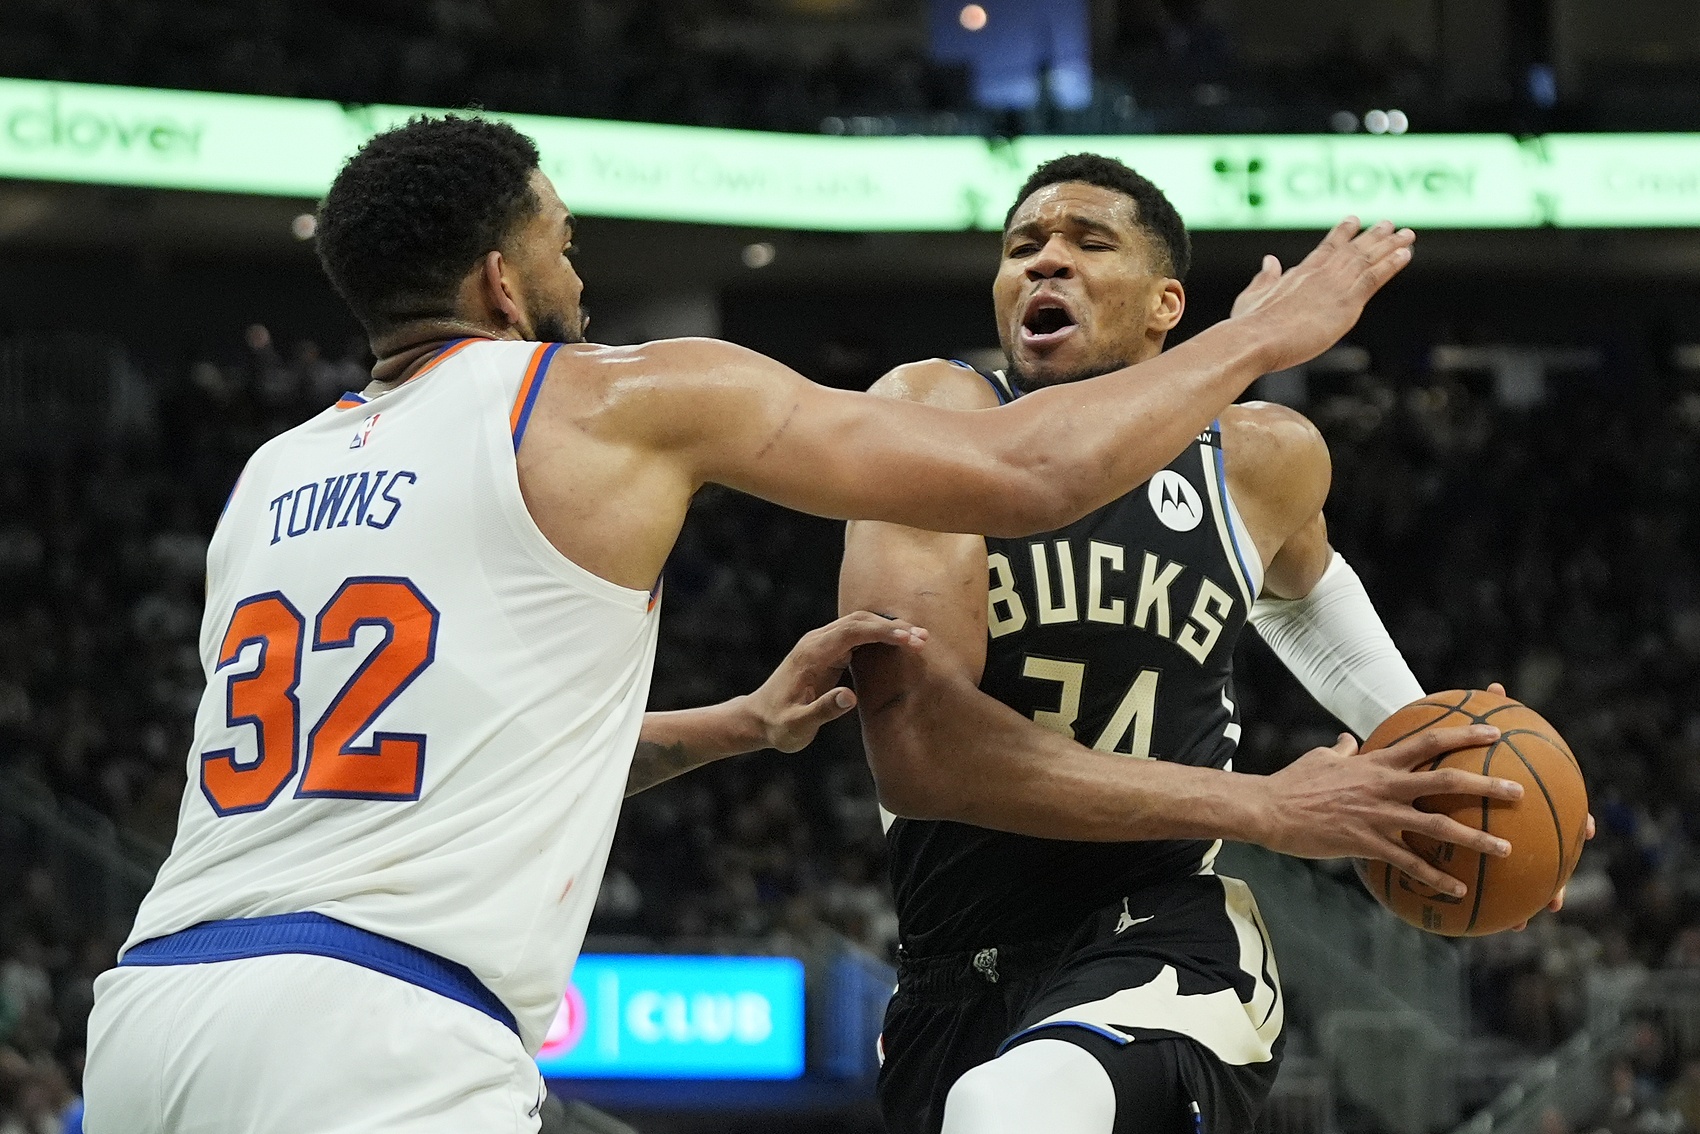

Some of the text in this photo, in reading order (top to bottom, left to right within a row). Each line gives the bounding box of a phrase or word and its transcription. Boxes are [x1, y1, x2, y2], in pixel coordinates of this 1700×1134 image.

[7, 86, 204, 160] clover
[1285, 142, 1476, 203] clover
[269, 470, 418, 546] TOWNS
[987, 538, 1235, 666] BUCKS
[200, 575, 441, 817] 32
[628, 990, 772, 1043] CLUB
